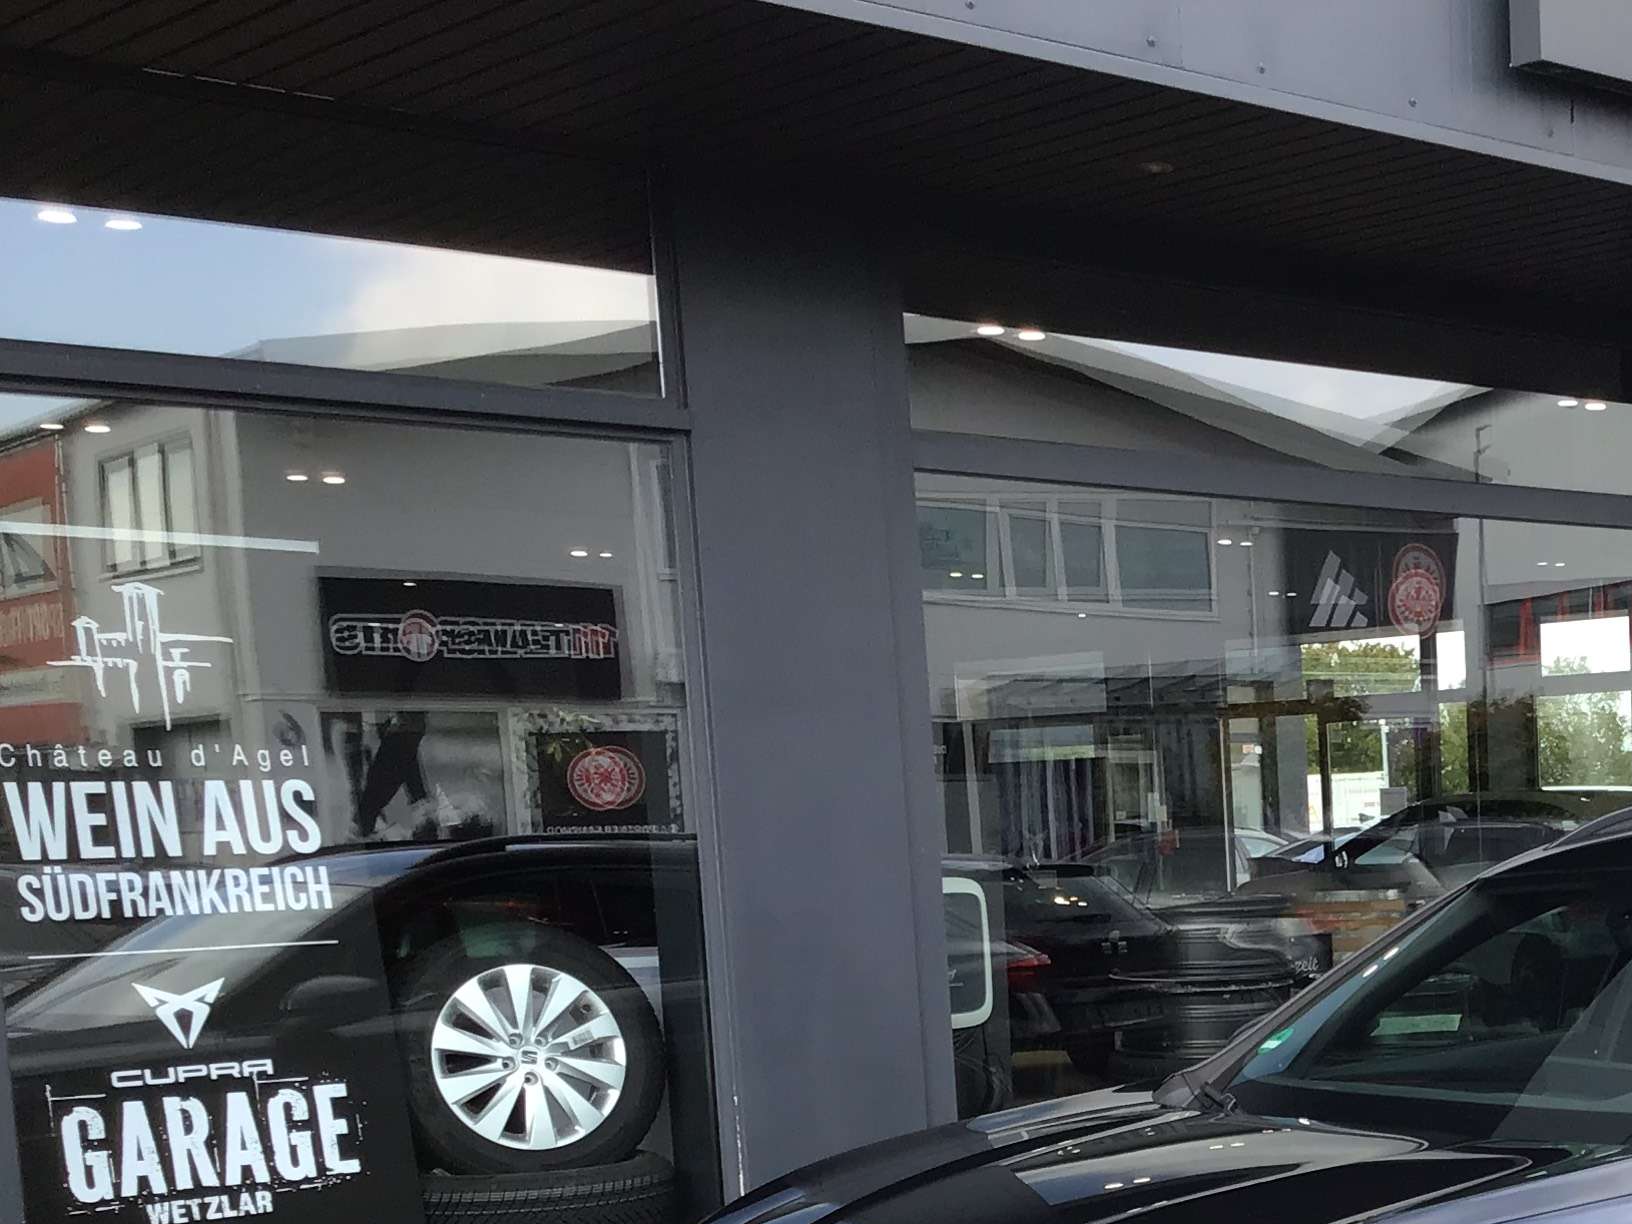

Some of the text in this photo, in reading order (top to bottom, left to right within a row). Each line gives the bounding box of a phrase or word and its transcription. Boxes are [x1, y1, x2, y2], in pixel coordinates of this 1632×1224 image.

[0, 743, 309, 773] Château d'Agel
[3, 778, 322, 861] WEIN AUS
[17, 866, 333, 922] SÜDFRANKREICH
[110, 1059, 275, 1088] CUPRA
[61, 1083, 362, 1204] GARAGE
